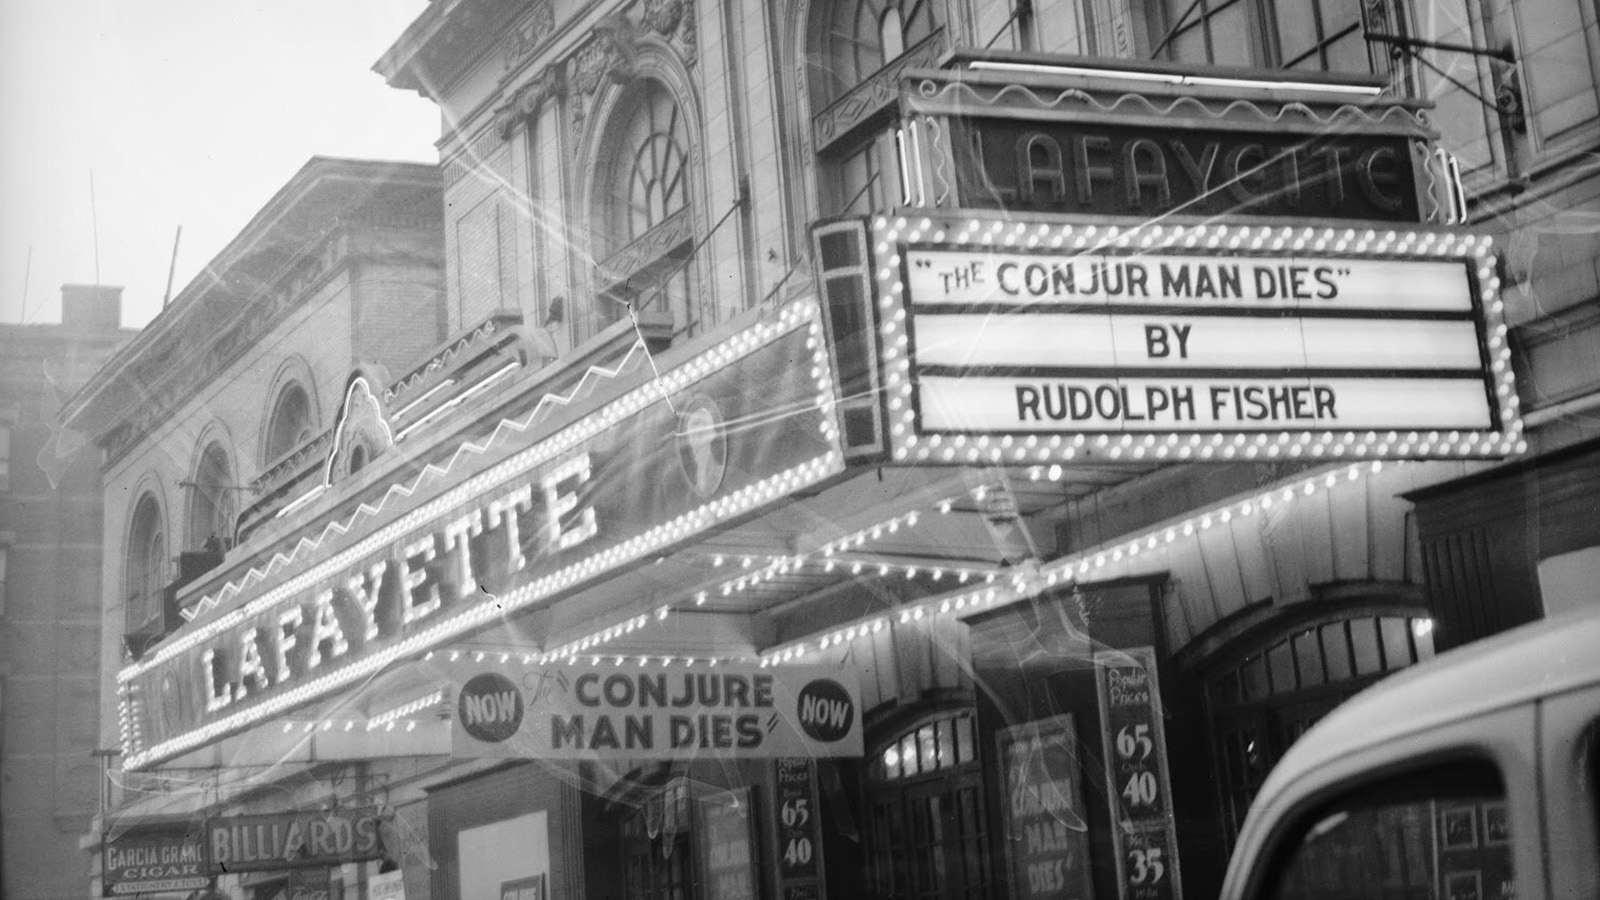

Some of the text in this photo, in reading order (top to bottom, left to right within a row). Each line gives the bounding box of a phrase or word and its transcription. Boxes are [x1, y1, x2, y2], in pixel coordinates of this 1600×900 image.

[973, 131, 1399, 212] LAFAYETTE
[996, 260, 1149, 299] CONJUR
[1159, 264, 1242, 300] MAN
[1144, 324, 1192, 361] BY
[1015, 383, 1338, 423] RUDOLPH FISHER
[201, 453, 600, 713] LAFAYETTE
[464, 691, 518, 725] NOW
[802, 695, 848, 730] NOW
[550, 714, 655, 750] MAN
[1116, 723, 1153, 760] 65
[1122, 770, 1158, 807] 40
[781, 798, 809, 827] 65
[212, 816, 376, 862] BILLIARDS
[783, 837, 813, 867] 40
[107, 846, 158, 871] GARCIA
[123, 863, 199, 879] CIGAR
[1127, 846, 1164, 886] 35
